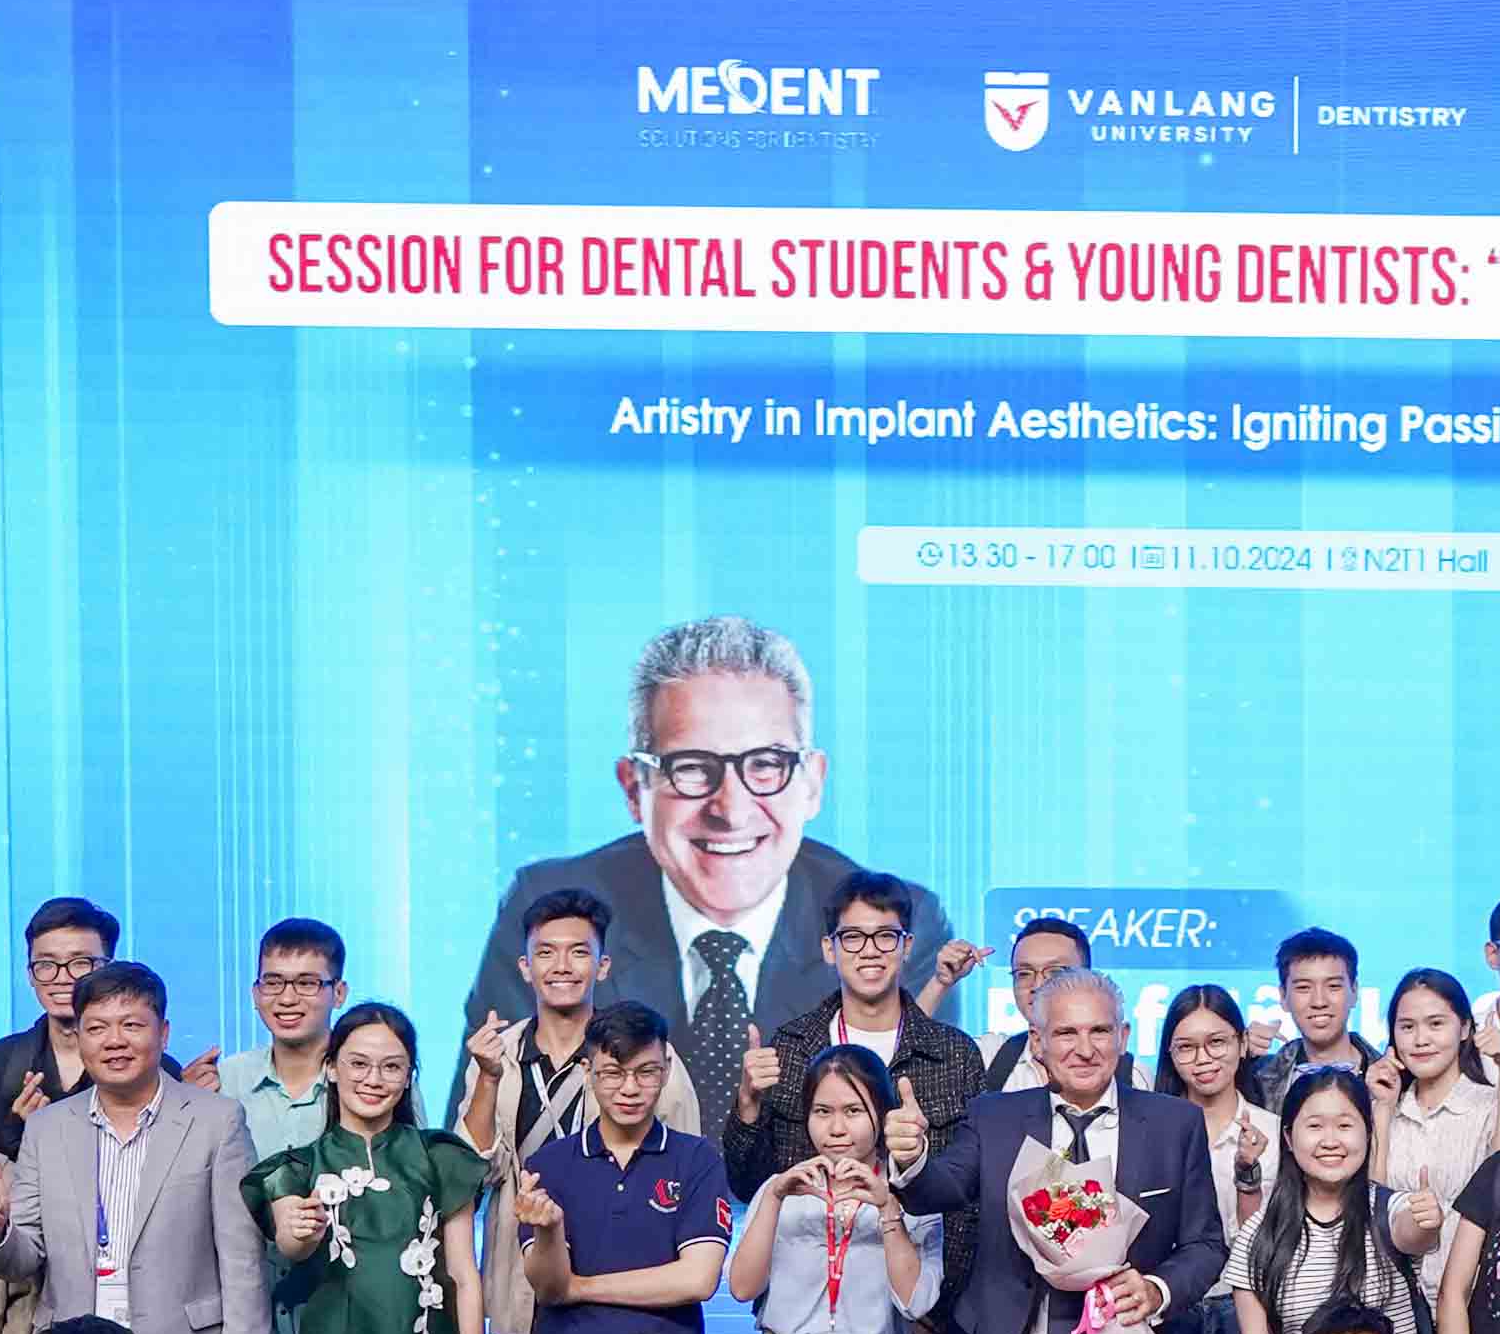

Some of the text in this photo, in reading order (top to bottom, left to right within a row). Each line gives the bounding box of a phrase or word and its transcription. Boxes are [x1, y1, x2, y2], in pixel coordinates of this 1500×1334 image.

[638, 60, 879, 115] MEDENT
[1092, 126, 1252, 142] UNIVERSITY
[1319, 106, 1466, 126] DENTISTRY
[269, 234, 460, 293] SESSION
[480, 236, 563, 295] FOR
[583, 237, 756, 297] DENTAL
[772, 239, 1007, 300] STUDENTS
[1025, 243, 1053, 300] &
[1068, 243, 1220, 302] YOUNG
[1238, 245, 1468, 305] DENTISTS:
[611, 398, 752, 443] Artistry
[766, 399, 800, 435] in
[816, 399, 975, 444] Implant
[988, 401, 1216, 440] Aesthetics:
[1233, 404, 1386, 452] Igniting
[951, 543, 1017, 568] 1330
[1048, 545, 1115, 569] 1700
[1174, 547, 1311, 571] 11.10.2024
[1439, 549, 1488, 573] Hall
